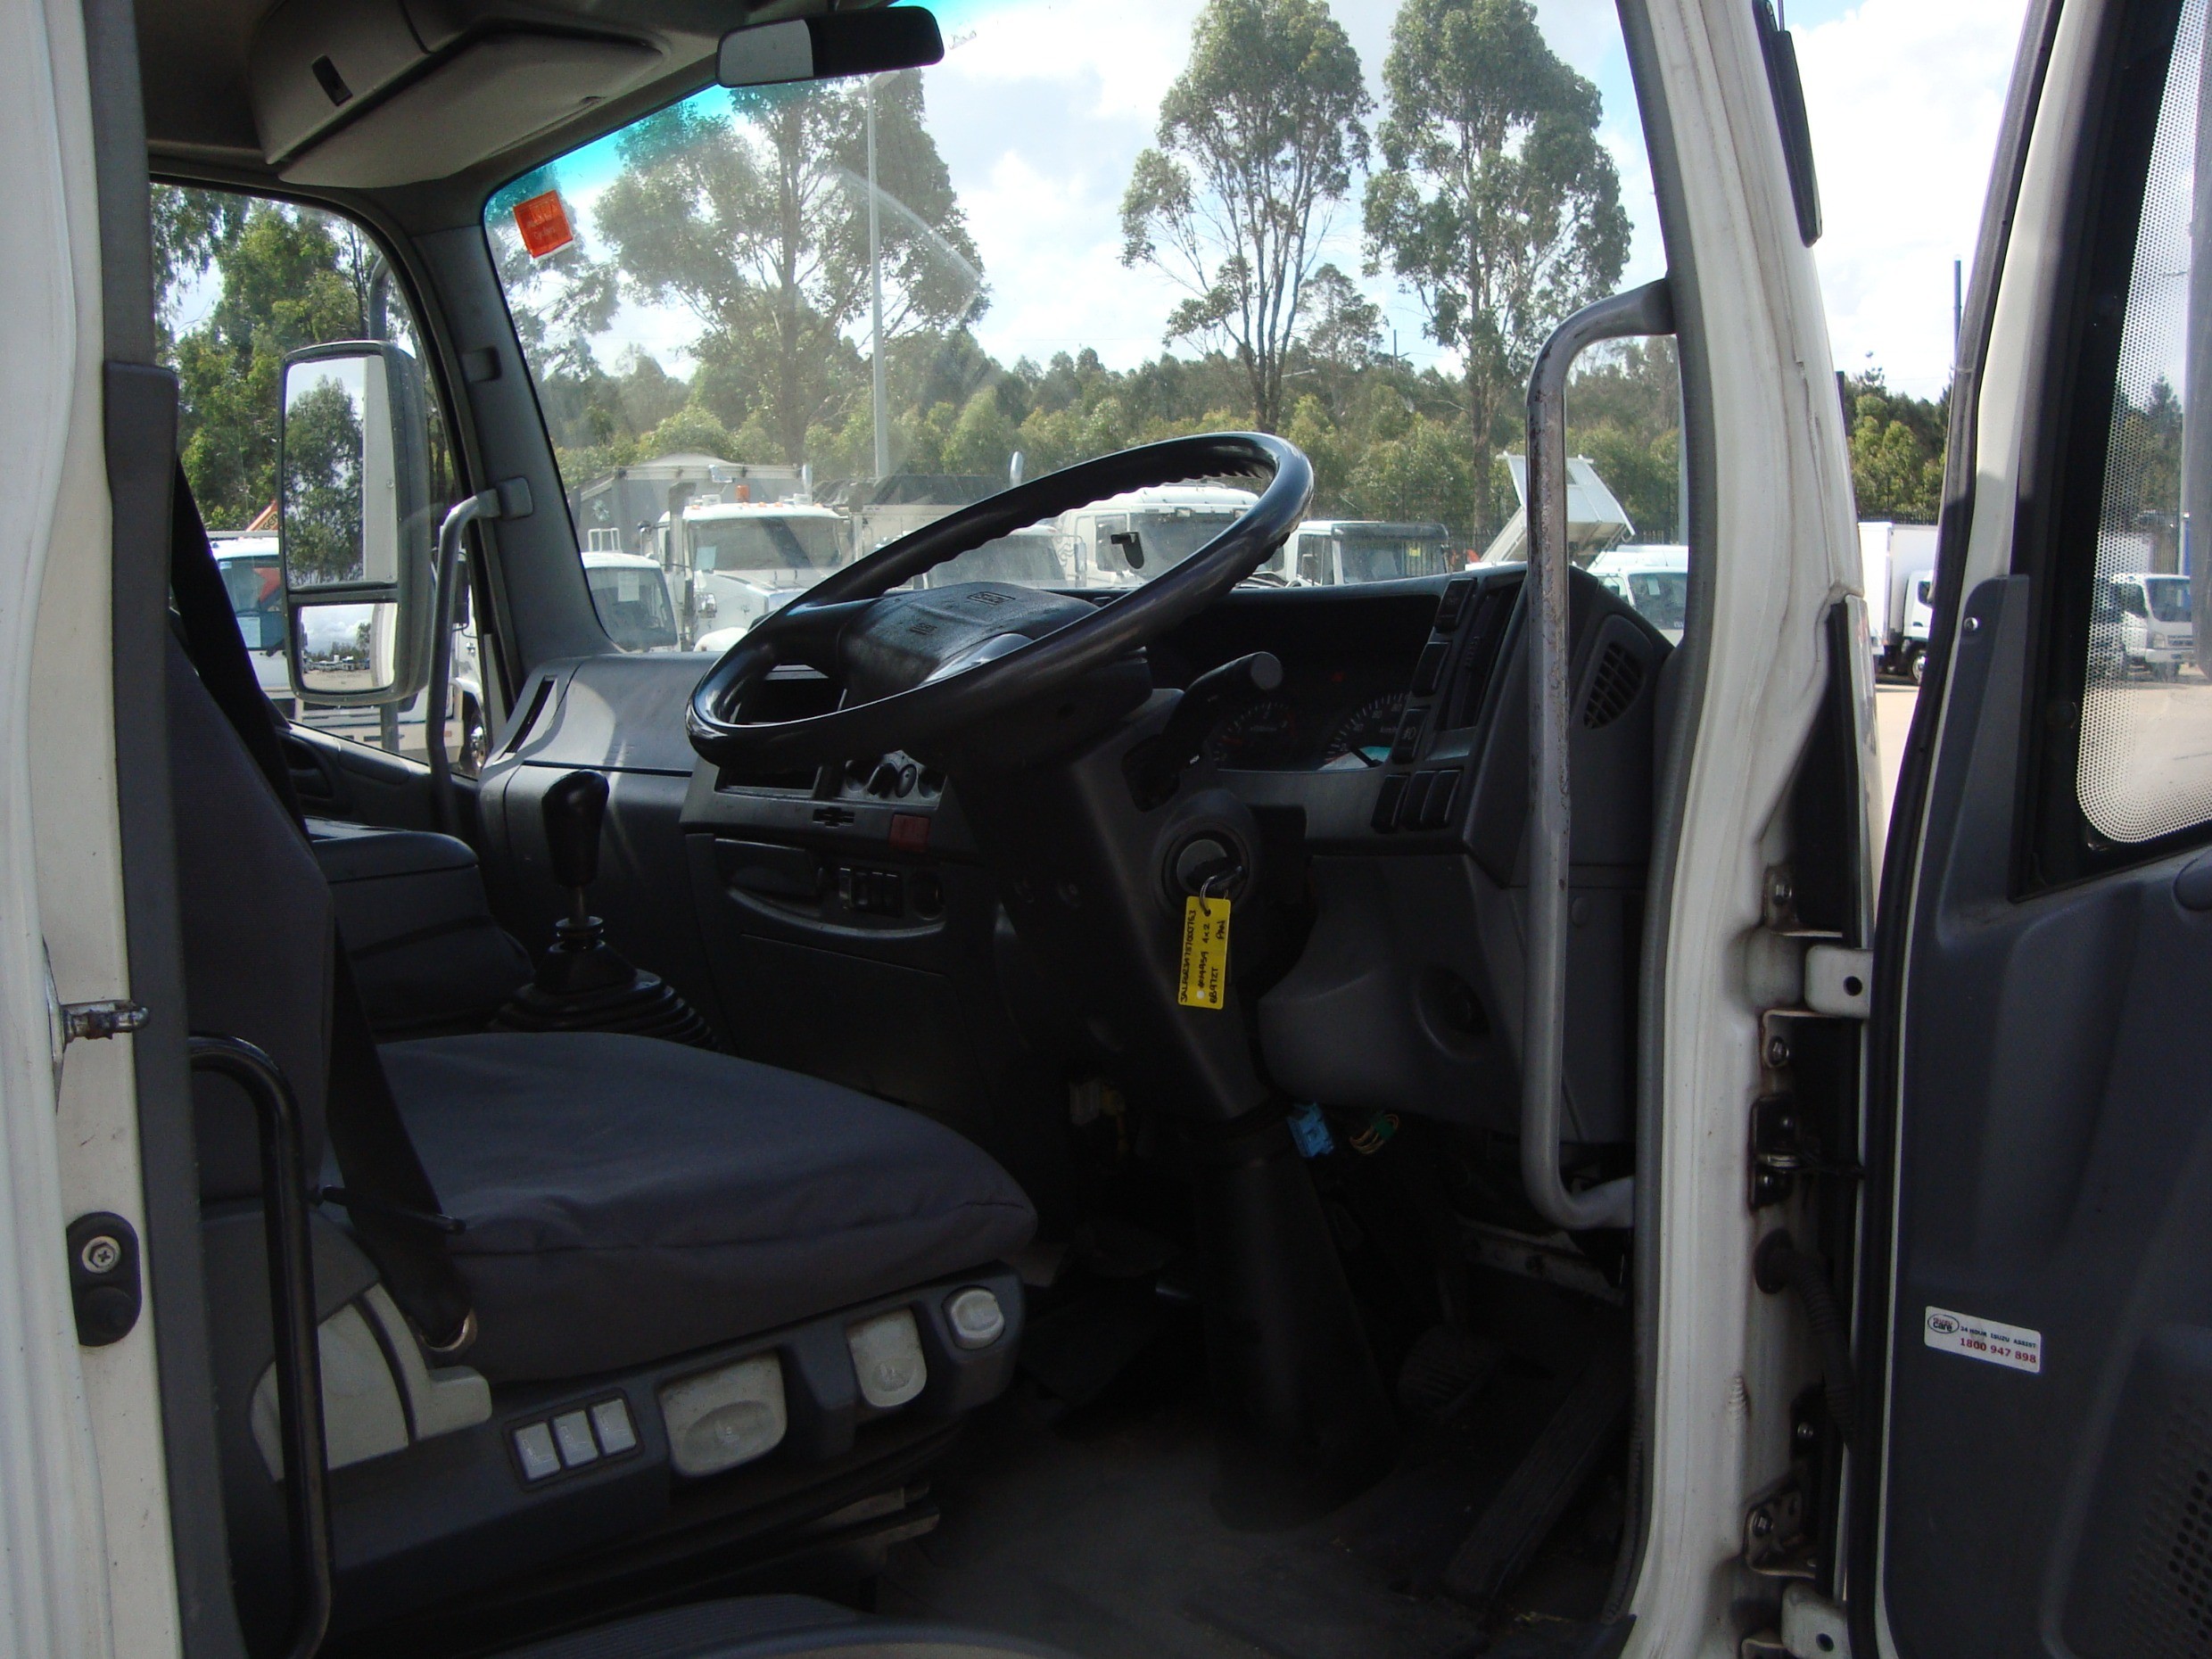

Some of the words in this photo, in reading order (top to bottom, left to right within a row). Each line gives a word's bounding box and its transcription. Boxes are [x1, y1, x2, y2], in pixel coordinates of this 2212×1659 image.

[1960, 1337, 1986, 1351] 1800
[1990, 1344, 2011, 1357] 947
[2014, 1350, 2036, 1364] 898
[1969, 1329, 1987, 1337] HOUR
[1990, 1333, 2010, 1342] ISUZU
[2013, 1339, 2036, 1349] ASSIST
